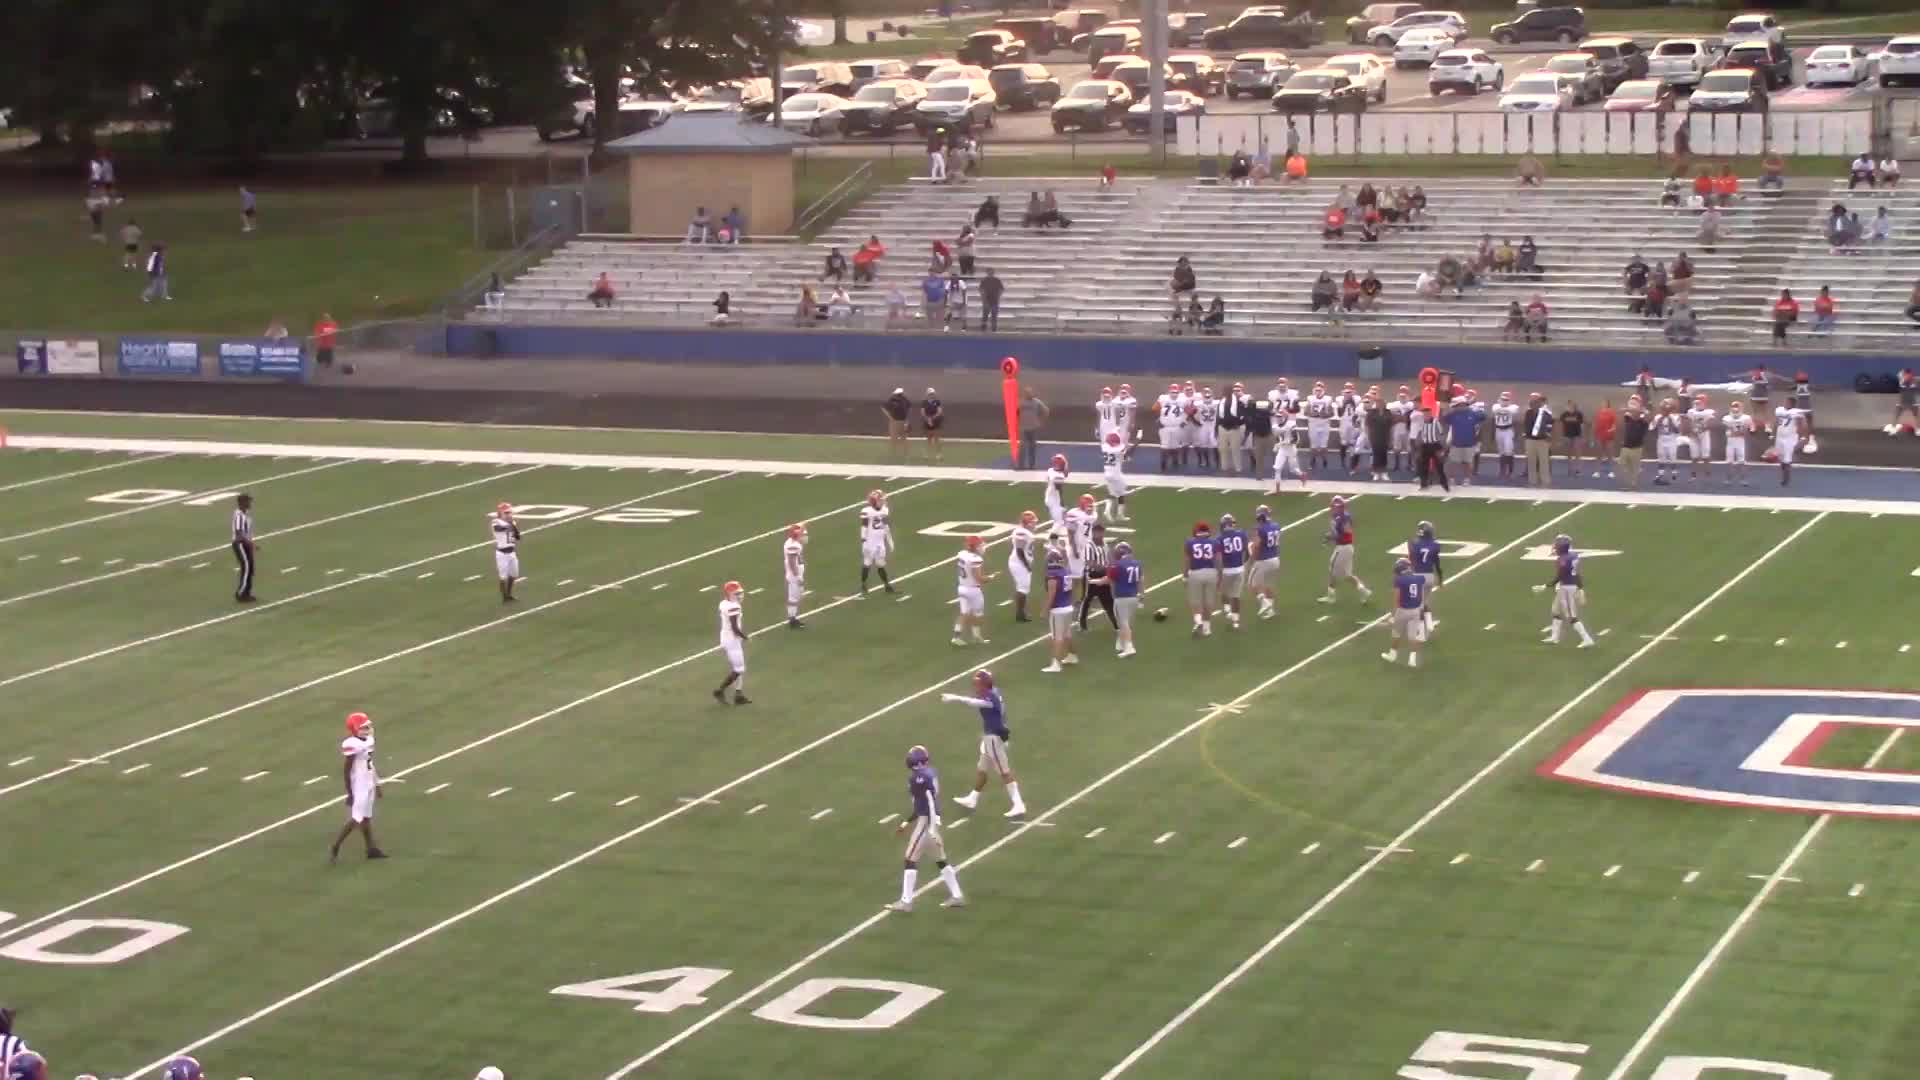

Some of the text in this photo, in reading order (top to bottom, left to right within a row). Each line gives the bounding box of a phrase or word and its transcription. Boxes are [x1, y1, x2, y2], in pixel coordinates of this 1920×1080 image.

[1191, 543, 1214, 560] 53
[1223, 536, 1243, 553] 50
[1419, 548, 1430, 563] 7
[1126, 566, 1140, 584] 71
[1408, 583, 1418, 599] 9
